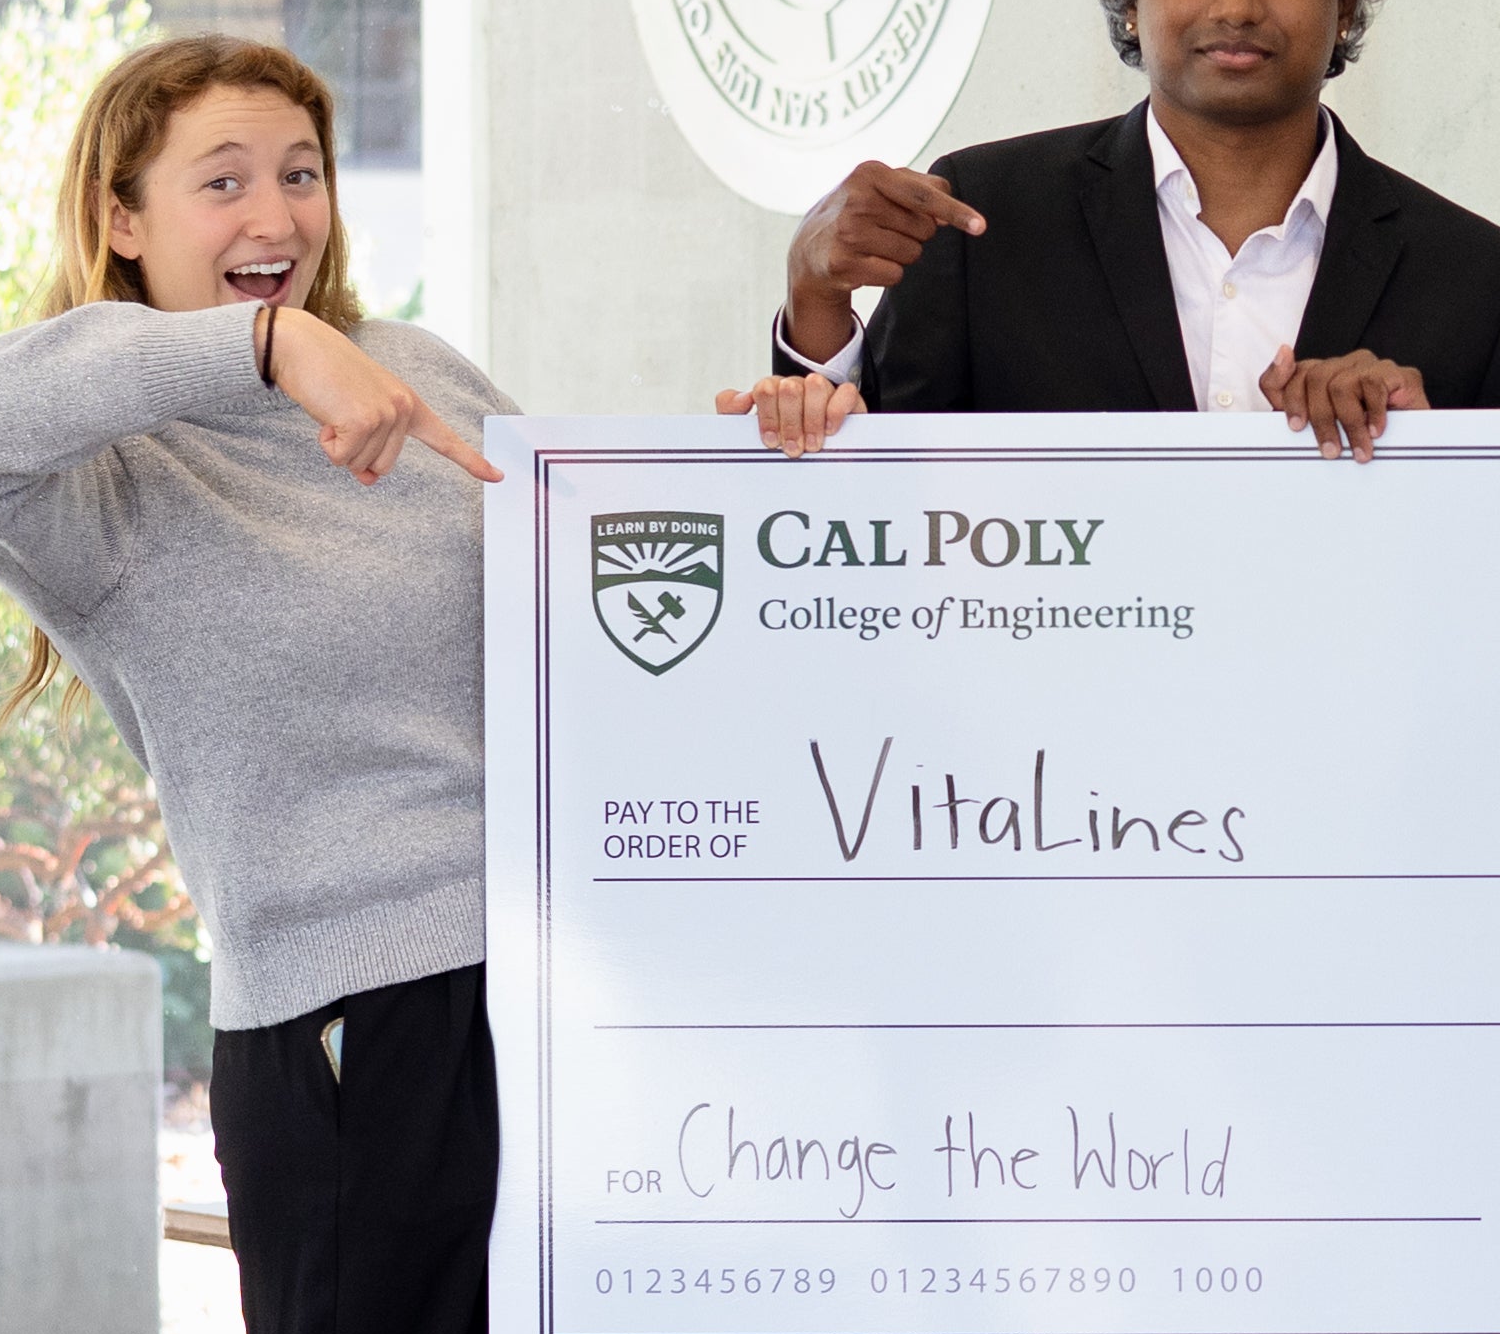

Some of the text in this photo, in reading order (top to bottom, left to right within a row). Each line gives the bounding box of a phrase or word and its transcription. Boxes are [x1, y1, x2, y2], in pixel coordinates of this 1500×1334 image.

[770, 85, 830, 129] SAN
[597, 520, 718, 537] LEARN BY DOING
[756, 510, 1105, 570] CAL POLY
[758, 596, 1195, 641] College of Engineering
[604, 800, 760, 825] PAY TO THE
[809, 736, 1246, 863] VitaLines
[603, 834, 748, 859] ORDER OF
[678, 1102, 1232, 1218] Change the World
[607, 1169, 662, 1194] FOR
[595, 1266, 1263, 1295] 0123456789 01234567890 1000
